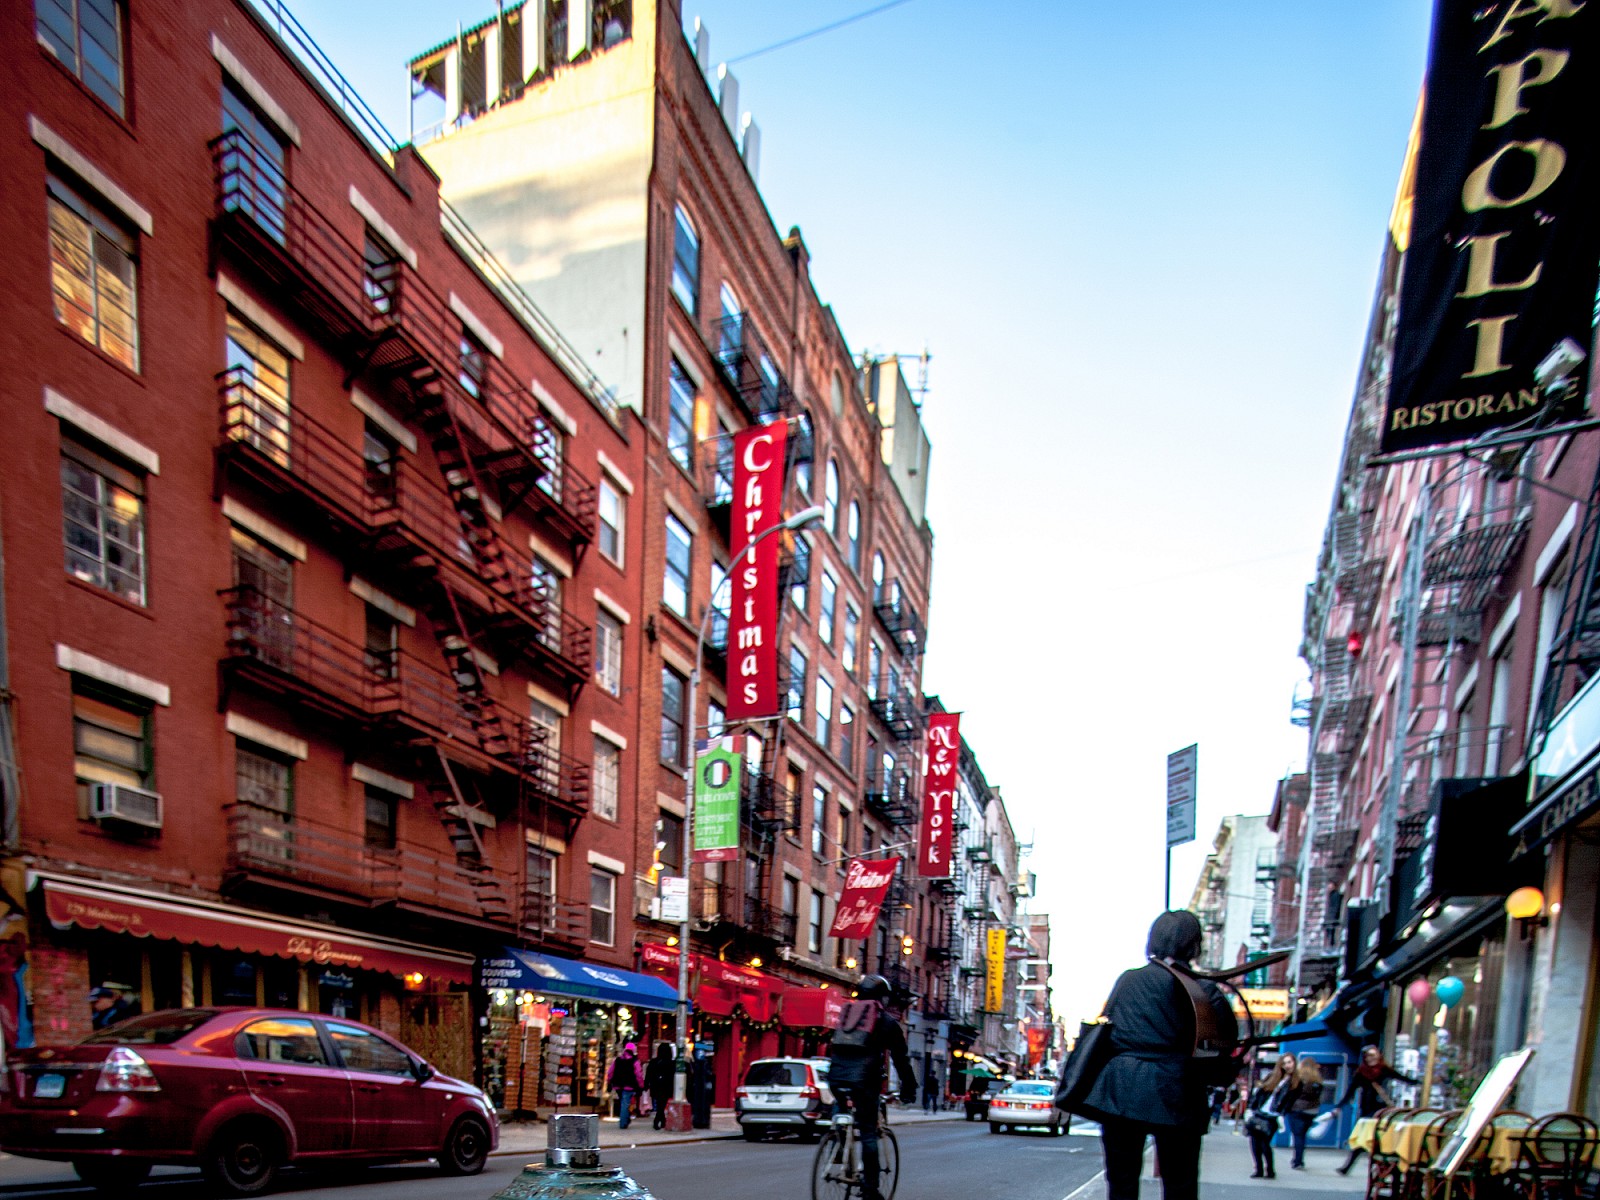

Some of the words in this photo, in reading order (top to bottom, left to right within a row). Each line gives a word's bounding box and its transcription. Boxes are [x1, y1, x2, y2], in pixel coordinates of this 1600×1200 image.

[1391, 375, 1580, 431] RISTORANE
[737, 434, 773, 705] Christmas
[929, 726, 958, 776] New
[697, 791, 737, 804] WELCOME
[927, 790, 951, 864] York
